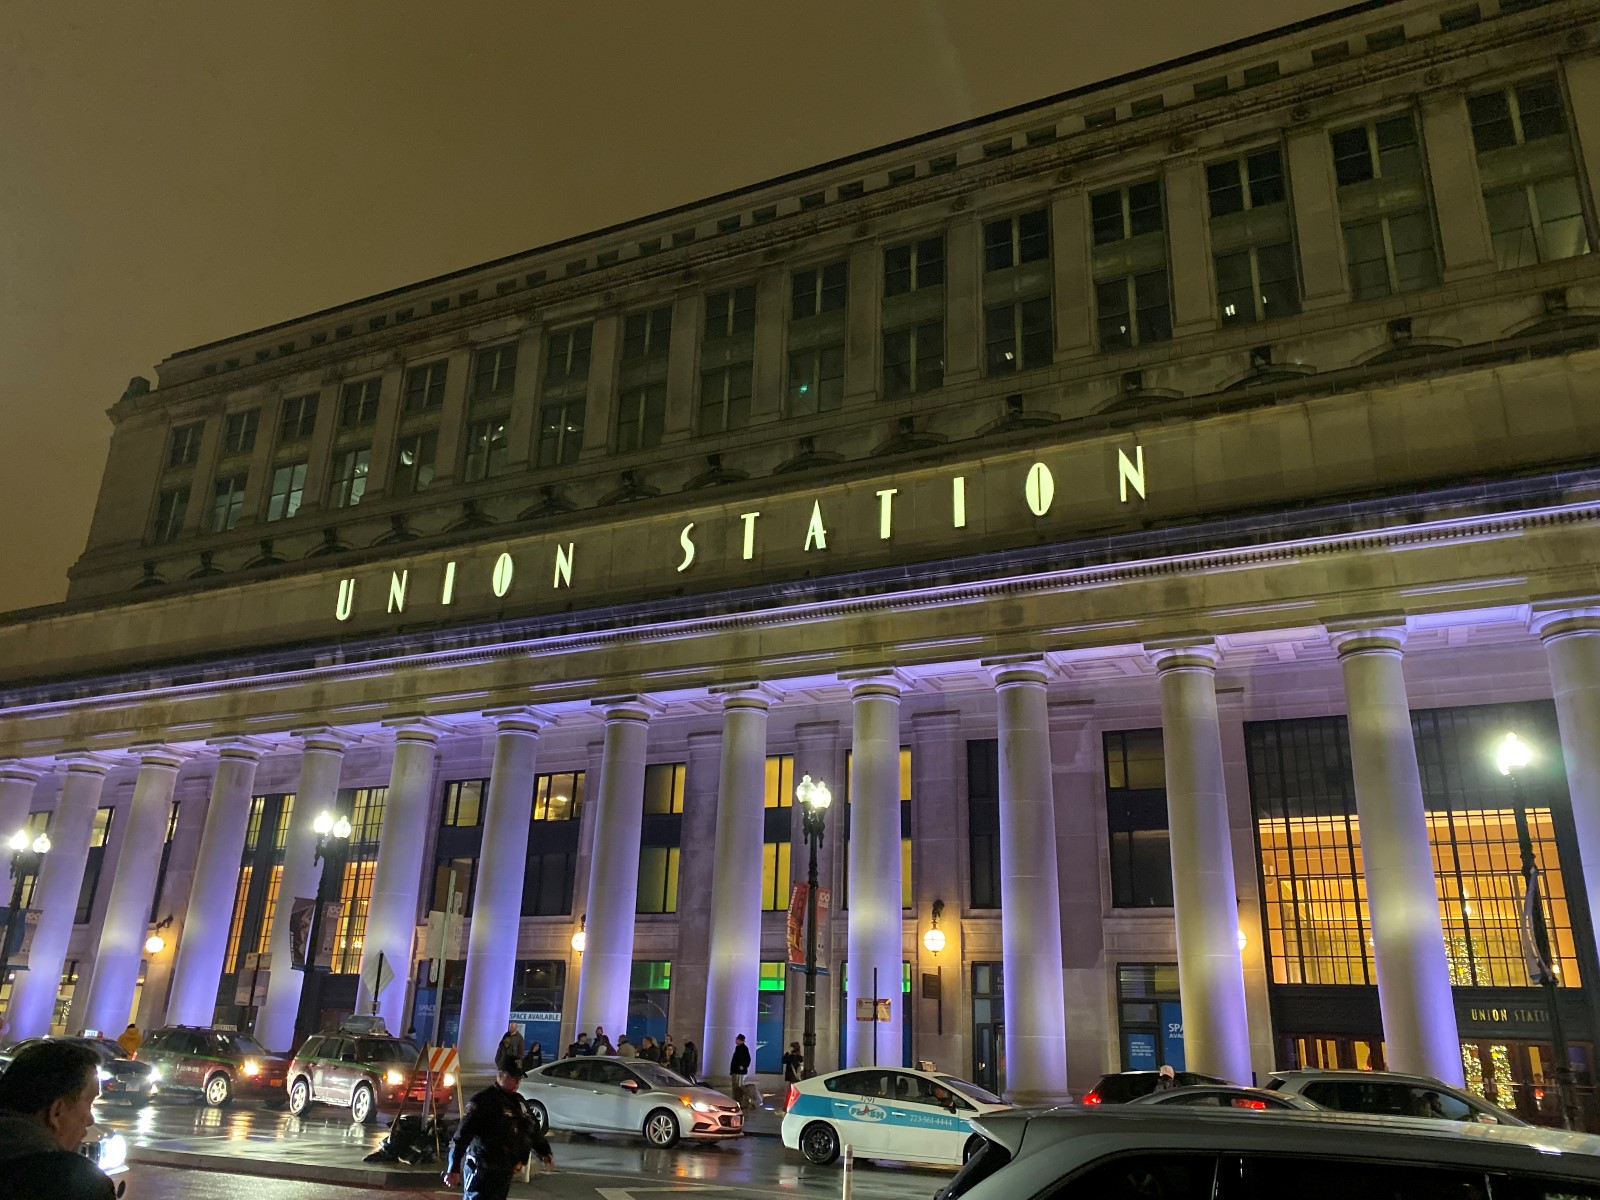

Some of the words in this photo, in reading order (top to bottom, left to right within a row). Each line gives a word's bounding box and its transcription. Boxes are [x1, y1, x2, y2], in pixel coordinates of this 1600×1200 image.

[334, 542, 575, 622] UNION
[677, 445, 1147, 572] STATION
[528, 1013, 559, 1021] AVAILABLE
[1471, 1008, 1508, 1021] UNION
[909, 1114, 953, 1127] 773-561-4444
